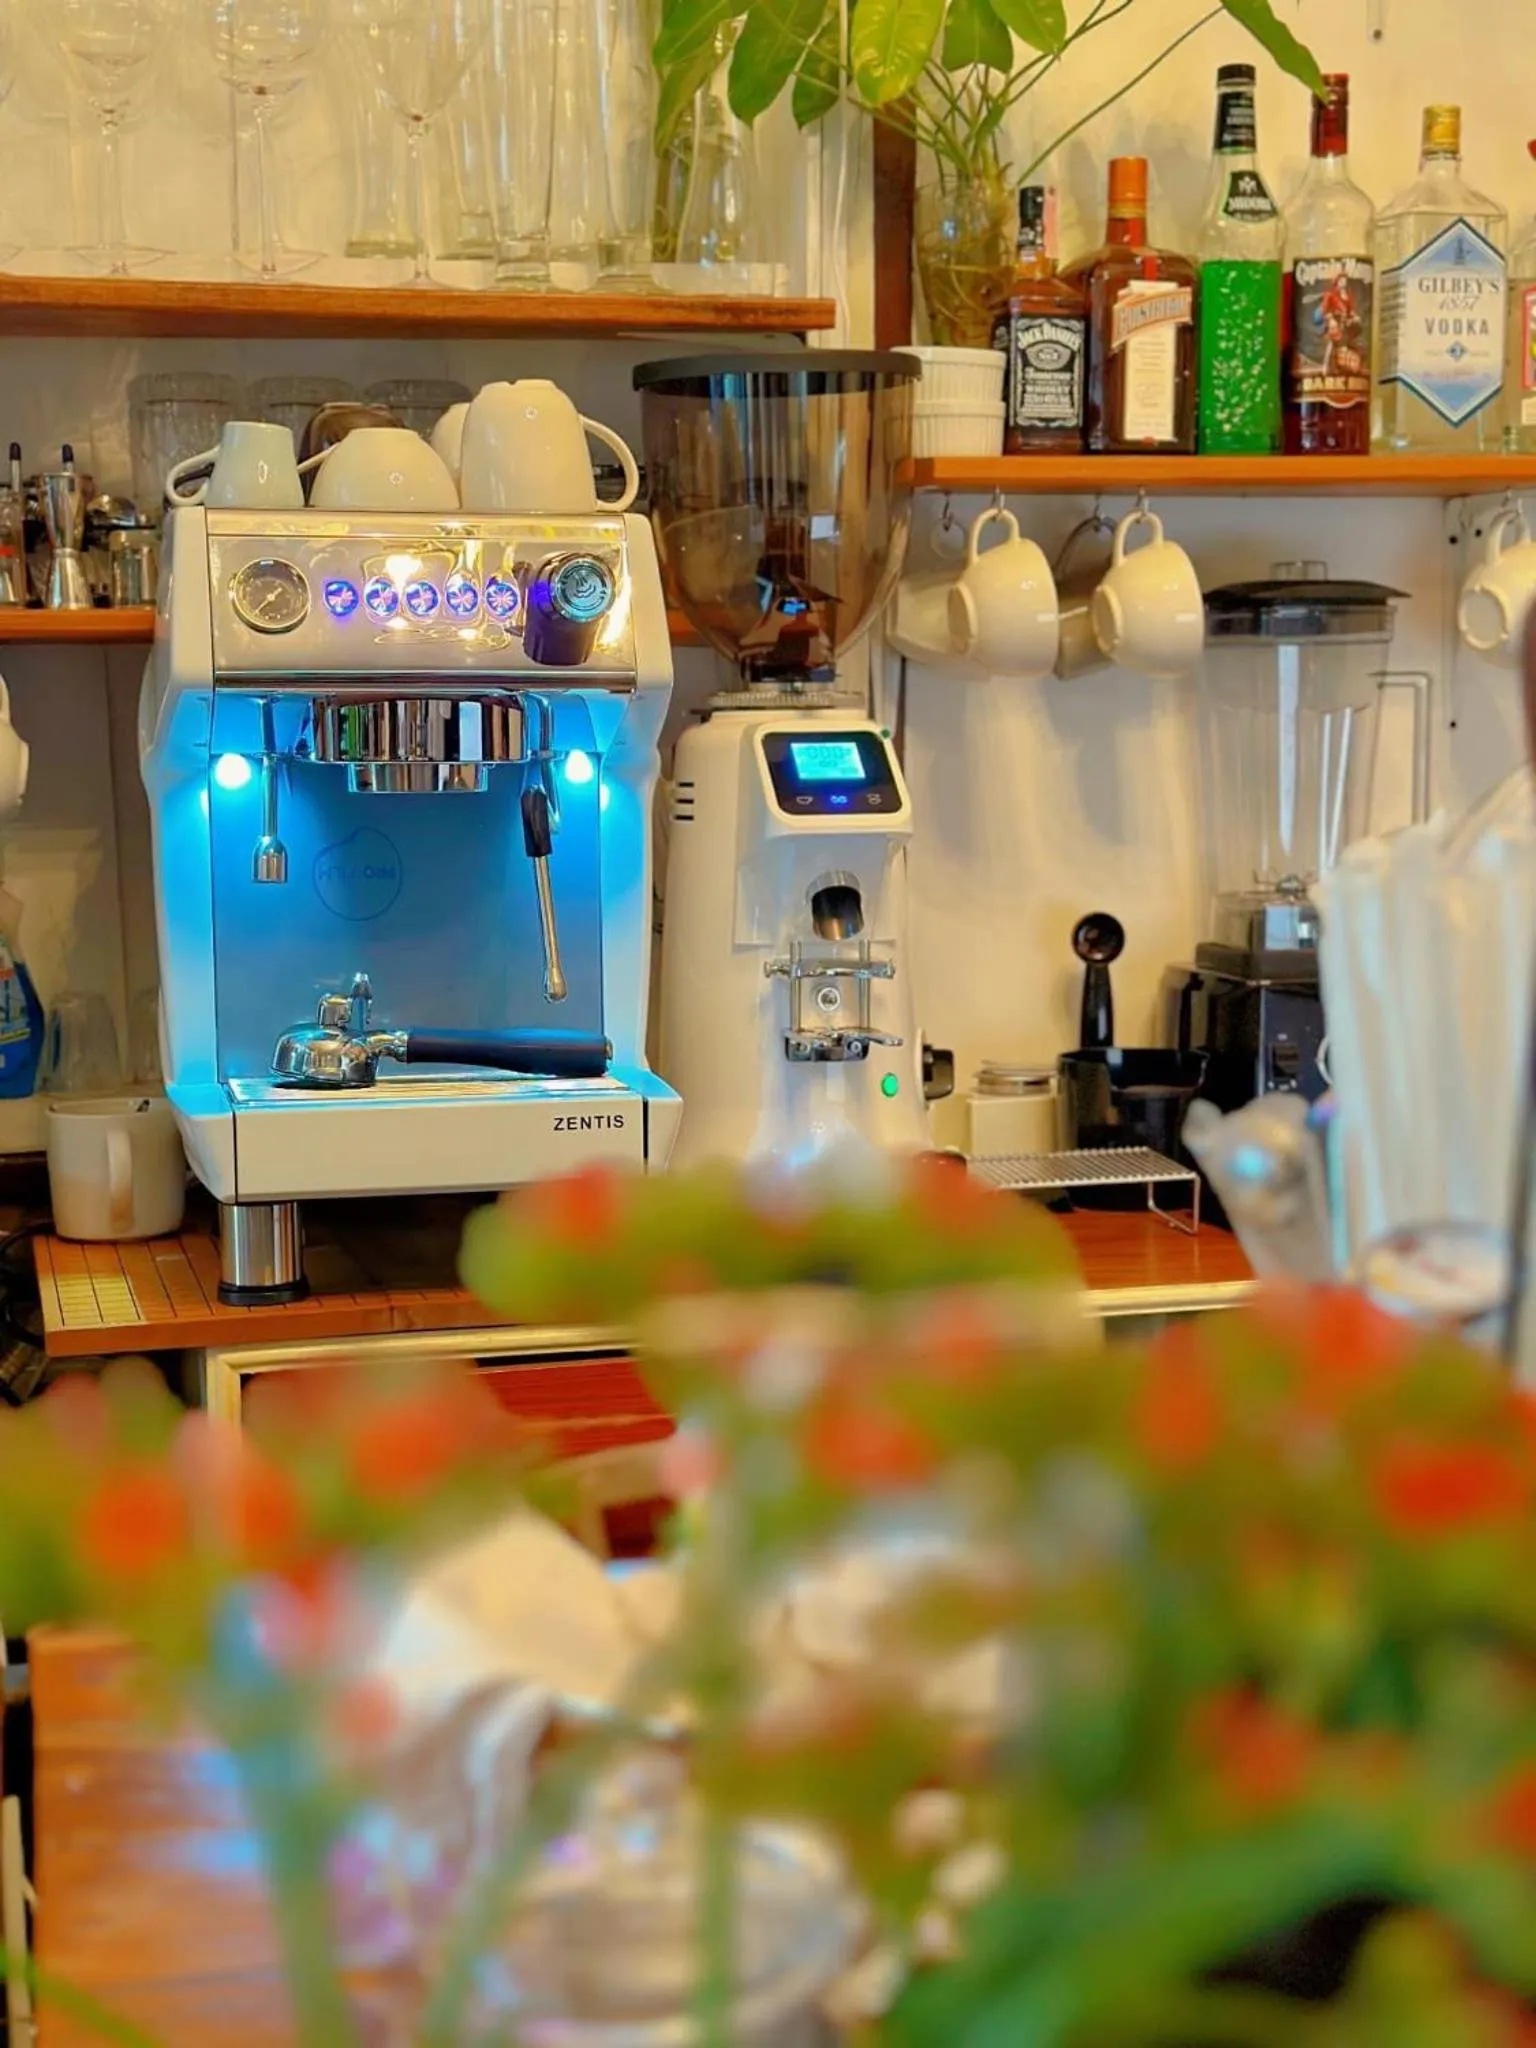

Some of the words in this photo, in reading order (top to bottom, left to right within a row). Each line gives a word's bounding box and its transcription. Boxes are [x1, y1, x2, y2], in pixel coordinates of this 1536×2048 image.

[1418, 277, 1500, 294] GILBEY'S
[1438, 296, 1481, 311] 1857
[1424, 317, 1490, 336] VODKA
[1302, 377, 1348, 392] DARK
[553, 1114, 624, 1131] ZENTIS
